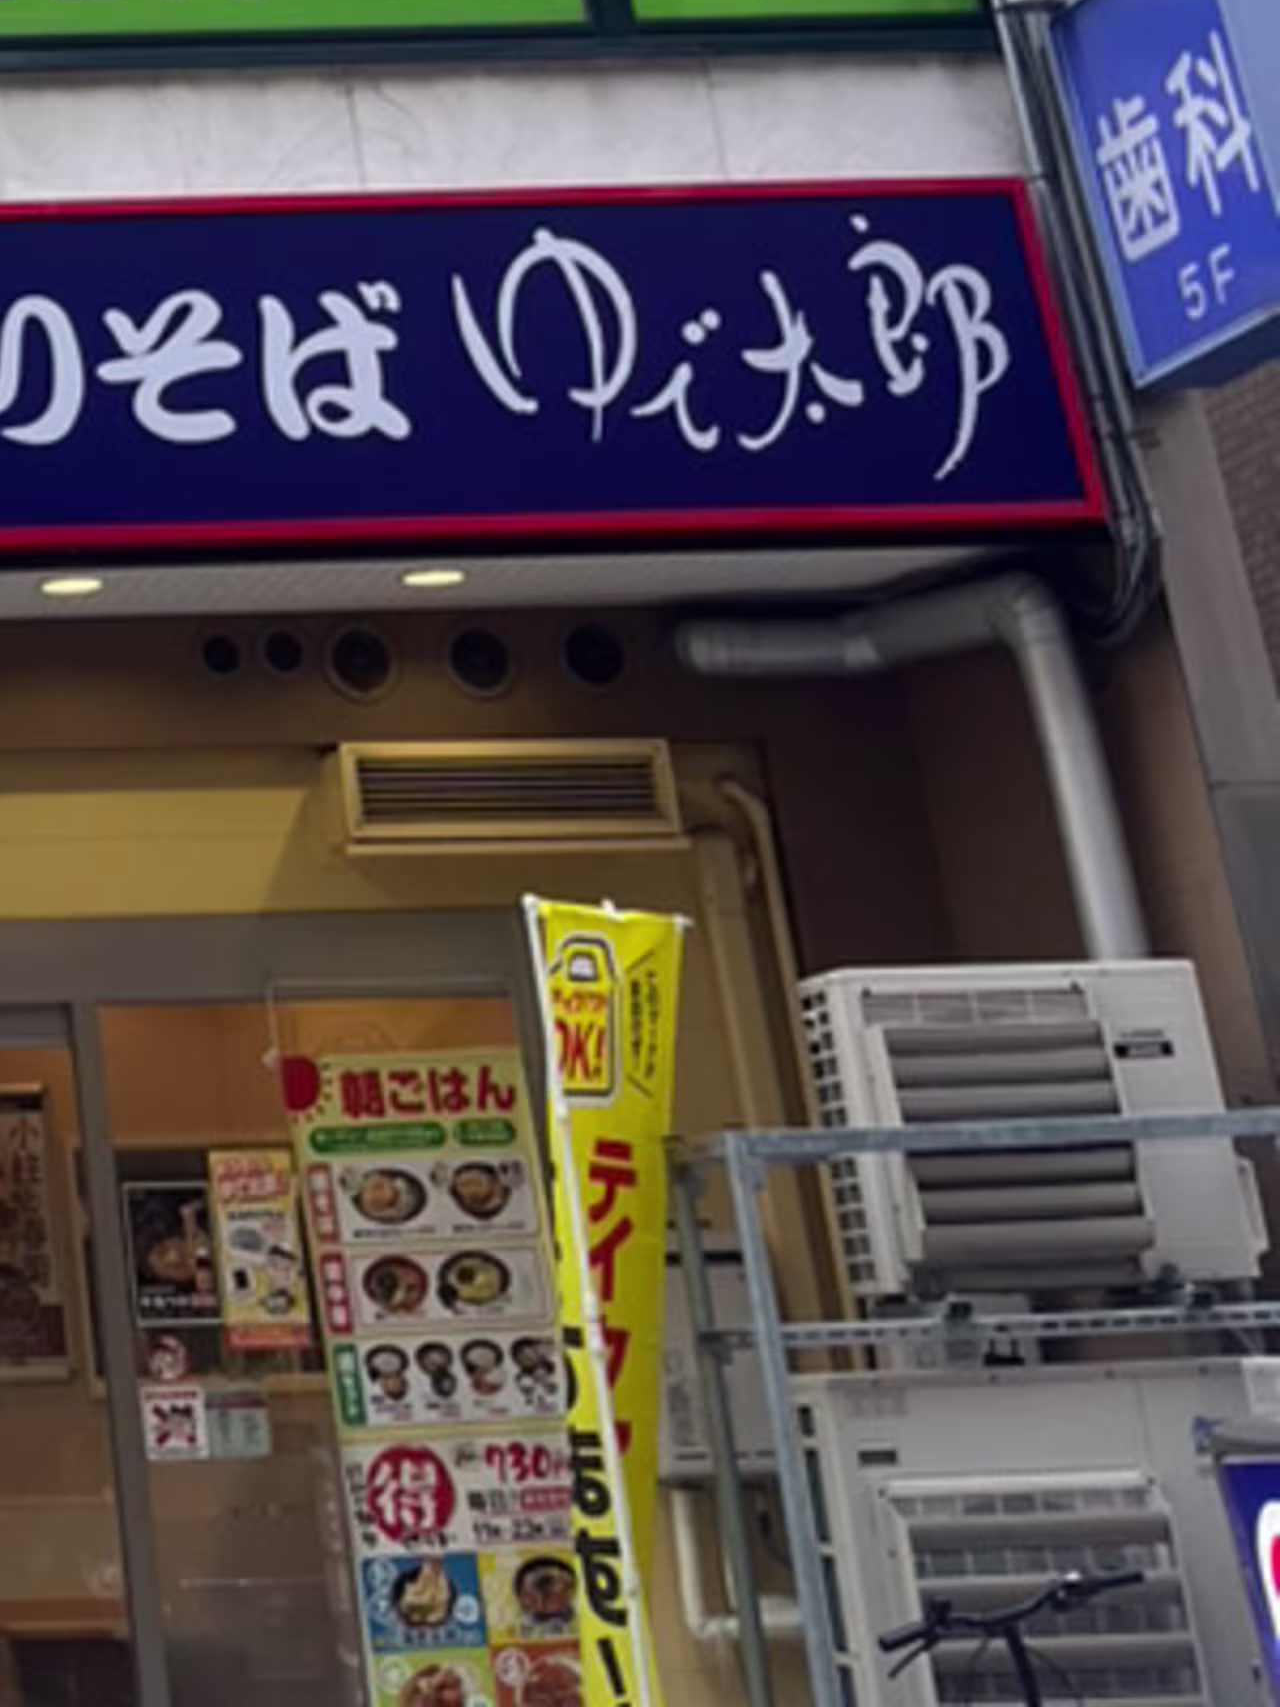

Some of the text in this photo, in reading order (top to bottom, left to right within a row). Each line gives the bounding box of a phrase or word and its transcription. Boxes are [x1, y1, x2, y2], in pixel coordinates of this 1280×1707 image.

[1096, 29, 1263, 265] 歯科
[1177, 242, 1235, 320] 5F
[339, 1063, 517, 1119] 朝ごはん
